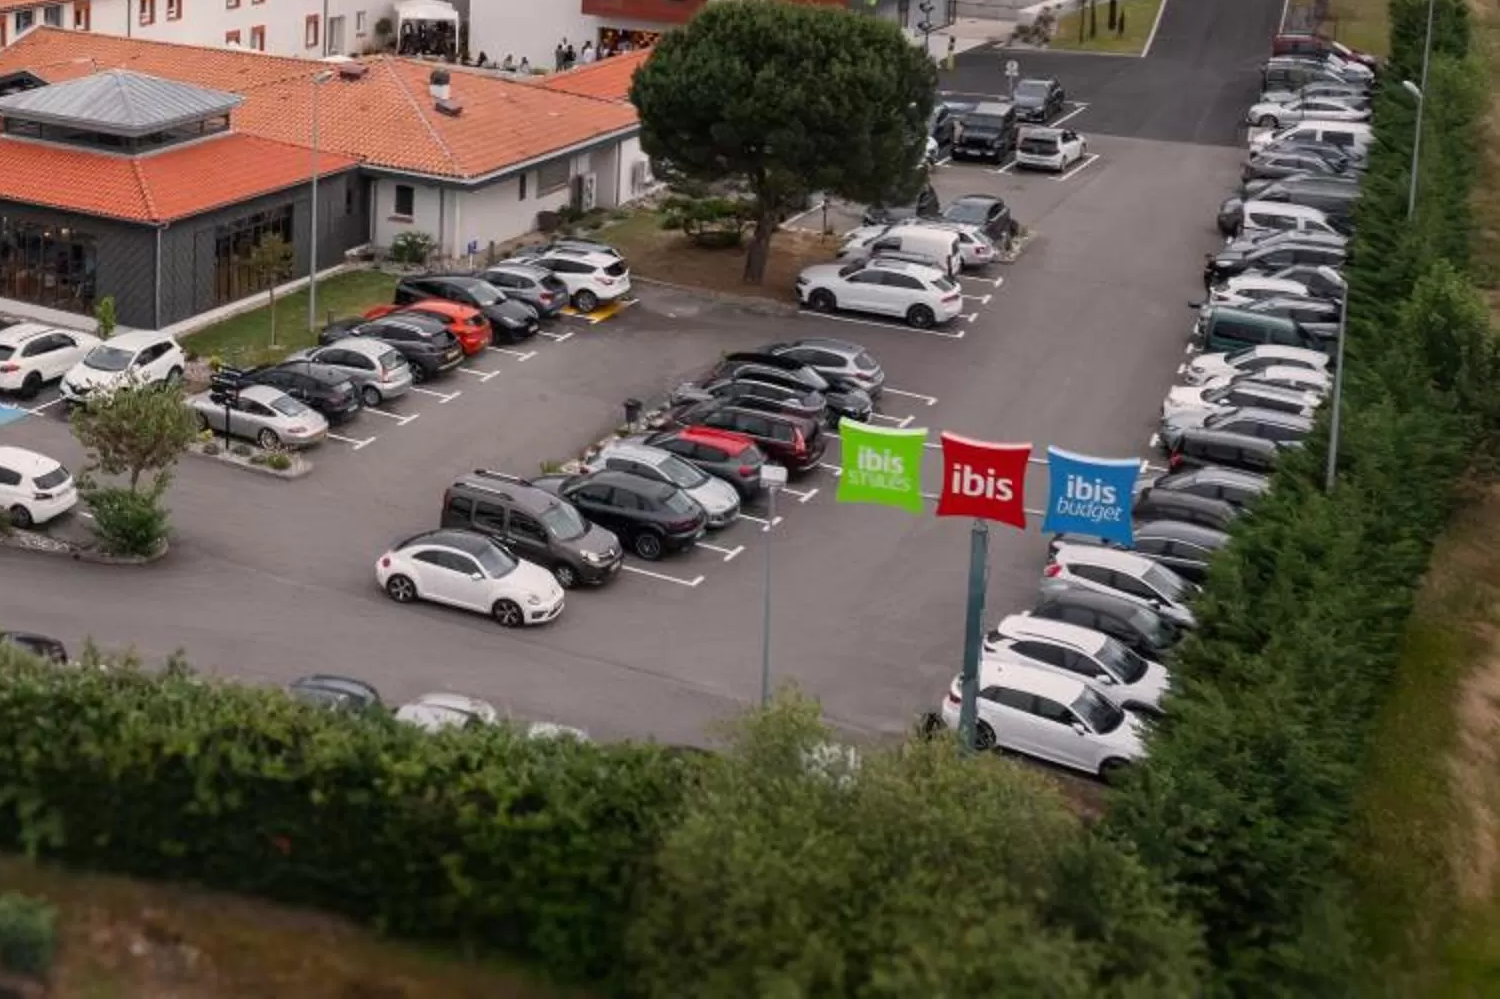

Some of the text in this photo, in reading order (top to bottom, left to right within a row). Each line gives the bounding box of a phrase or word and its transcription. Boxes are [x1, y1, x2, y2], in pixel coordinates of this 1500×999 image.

[858, 446, 904, 474] ibis
[951, 463, 1013, 501] ibis
[1067, 474, 1117, 504] ibis
[1056, 496, 1123, 522] budget
